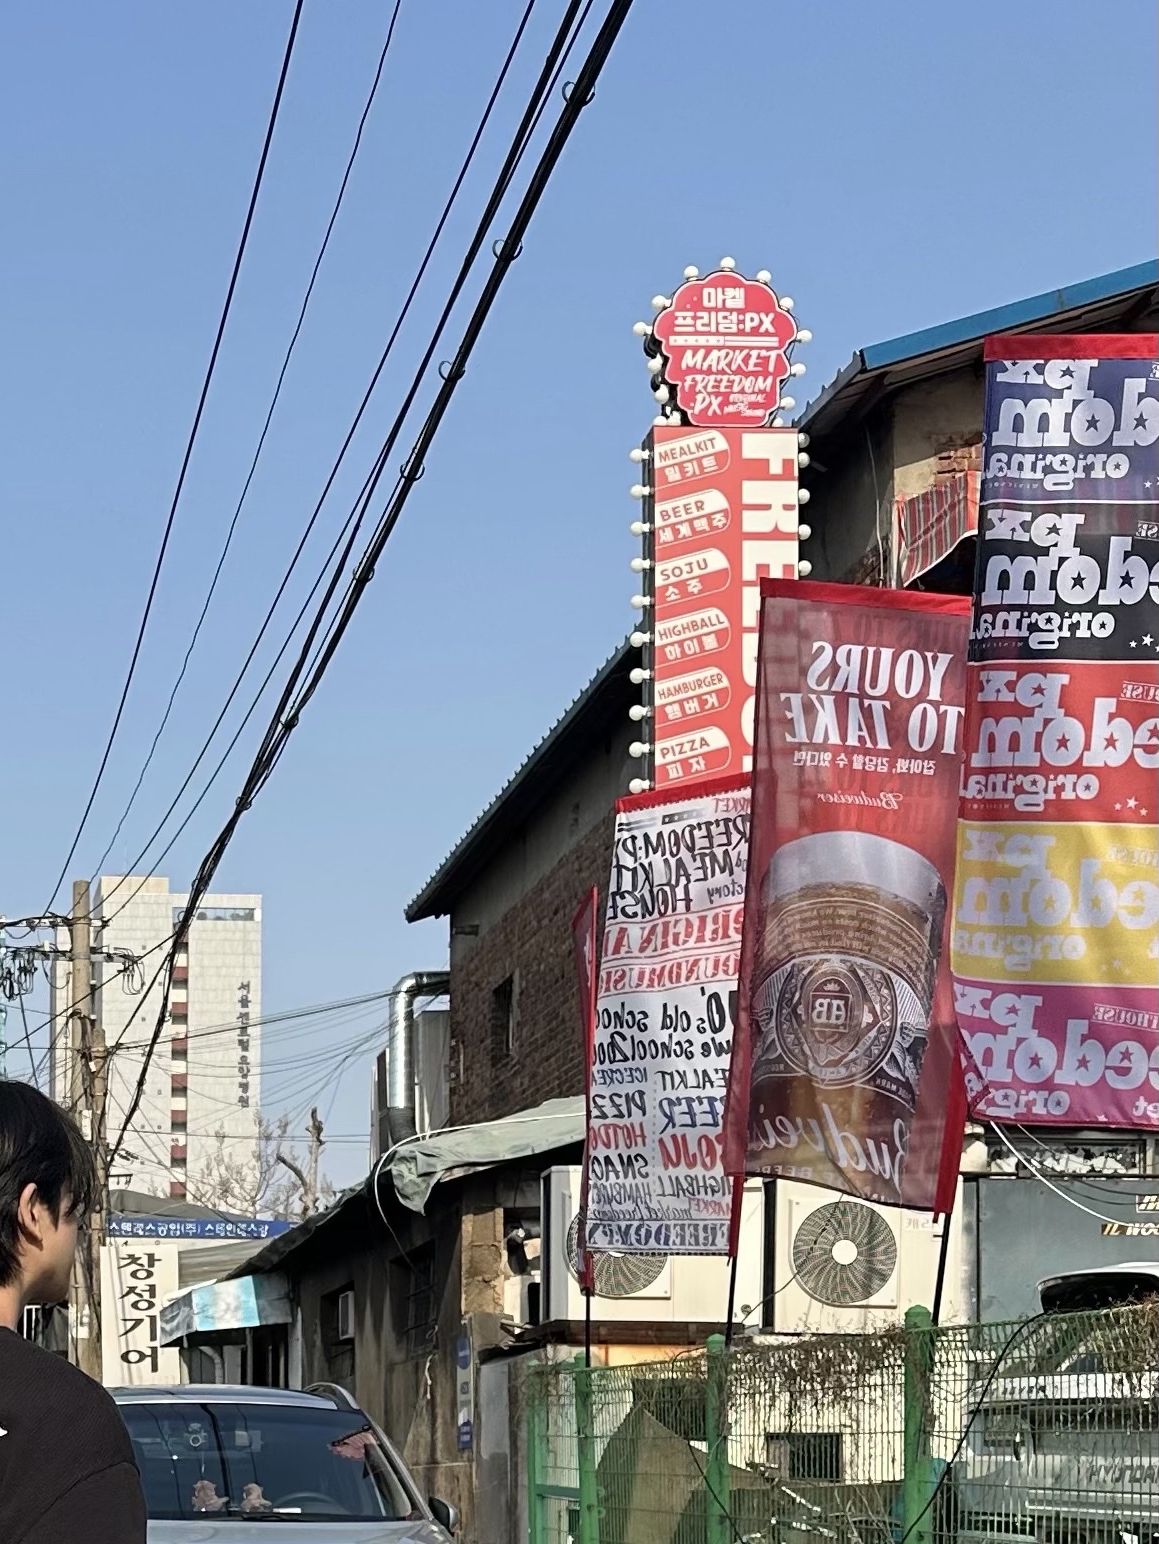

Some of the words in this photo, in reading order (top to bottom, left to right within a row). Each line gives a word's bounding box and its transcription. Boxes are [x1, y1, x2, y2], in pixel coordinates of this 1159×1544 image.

[673, 311, 776, 333] 프리덤:PX
[681, 348, 785, 374] MARKET
[683, 374, 773, 394] FREEDOM
[658, 437, 717, 463] MEALKIT
[664, 455, 719, 483] 밀키트
[660, 499, 705, 522] BEER
[658, 512, 727, 544] 세계맥주
[660, 558, 709, 581] SOJU
[664, 578, 703, 602] 소주
[658, 613, 726, 641] HIGHBALL
[664, 633, 719, 661] 하이볼
[658, 673, 724, 700] HAMBURGER
[664, 692, 719, 721] 햄버거
[660, 736, 710, 759] PIZZA
[666, 756, 706, 779] 피자
[118, 1252, 162, 1373] 창성기어
